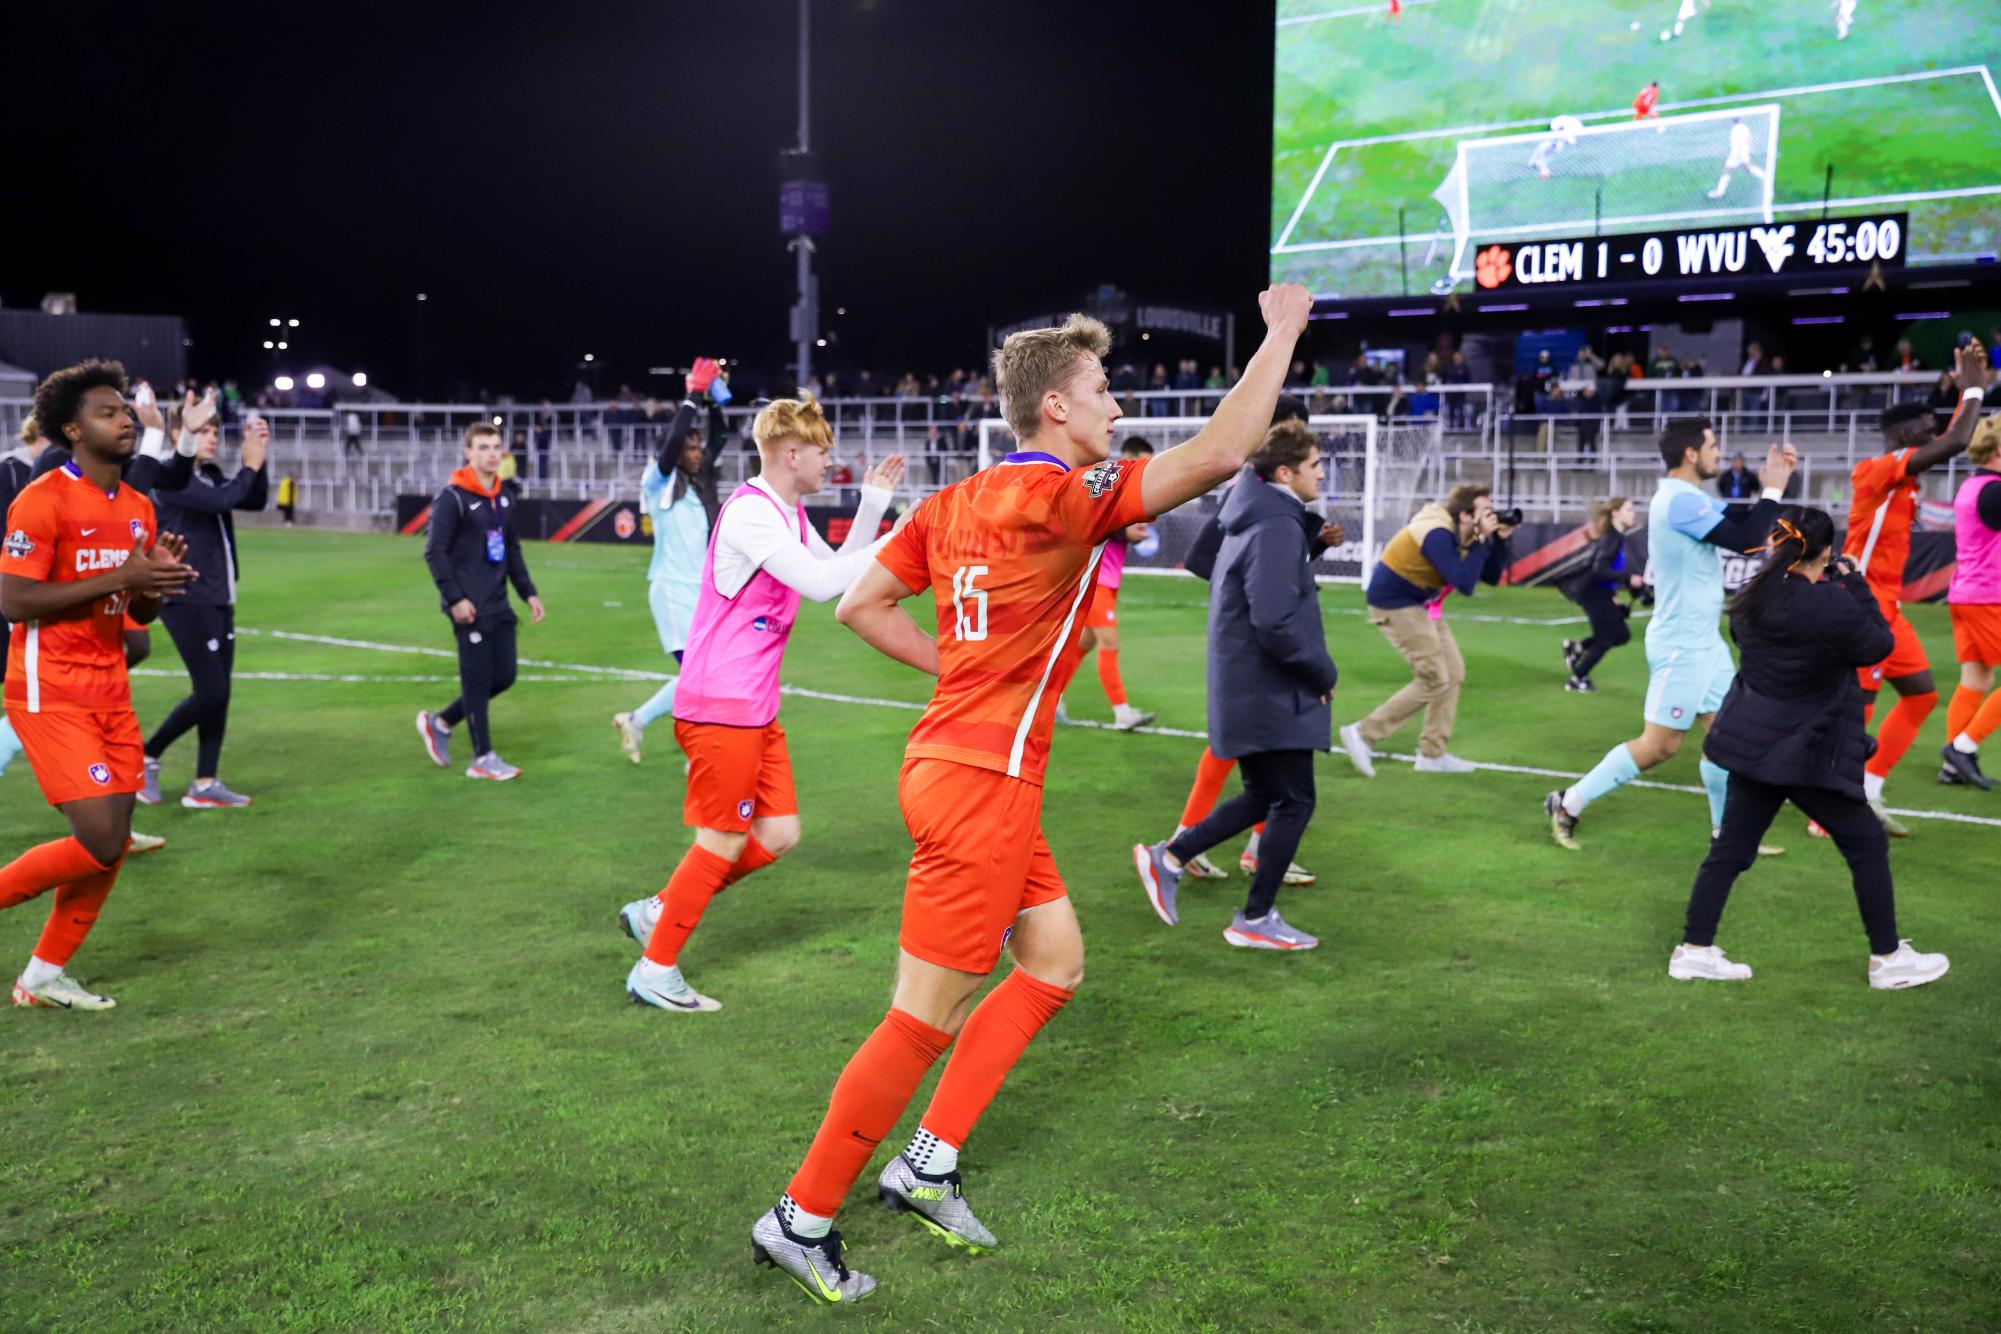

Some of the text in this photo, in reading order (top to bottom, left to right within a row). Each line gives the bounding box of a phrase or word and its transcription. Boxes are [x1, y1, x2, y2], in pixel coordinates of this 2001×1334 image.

[1515, 242, 1584, 284] CLEM
[1597, 242, 1608, 278] 1
[1642, 237, 1663, 275] 0
[1677, 231, 1748, 275] WVU
[1806, 219, 1900, 264] 45:00
[952, 565, 988, 641] 15
